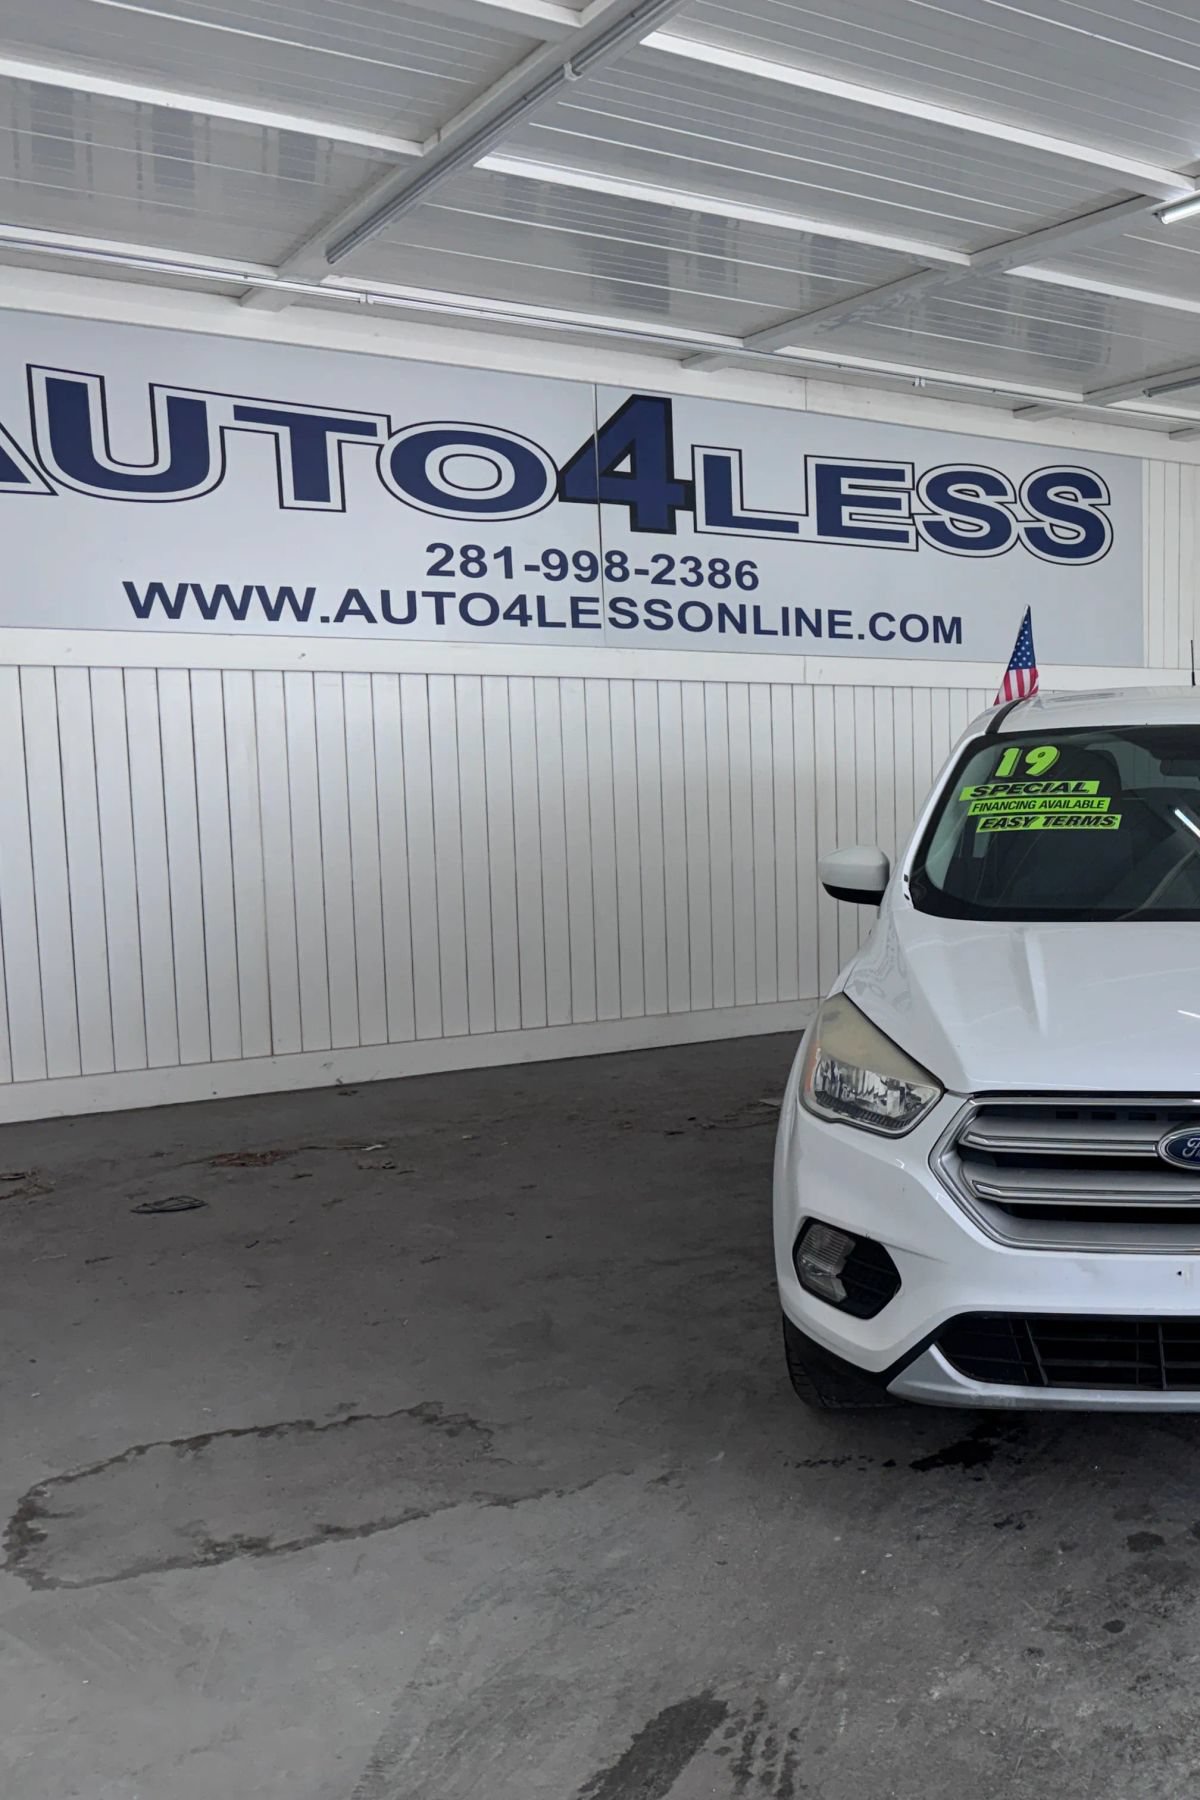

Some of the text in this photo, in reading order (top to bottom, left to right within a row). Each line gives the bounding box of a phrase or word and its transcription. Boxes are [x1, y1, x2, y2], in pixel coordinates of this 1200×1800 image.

[0, 364, 1113, 566] UTO4LESS
[425, 542, 759, 591] 281-998-2386
[122, 580, 962, 644] WWW.AUTO4LESSONLINE.COM
[996, 746, 1060, 777] 19
[970, 782, 1089, 798] SPECIAL
[972, 800, 1104, 812] FINANCING AVAILABLE
[979, 815, 1117, 831] EASY TERMS
